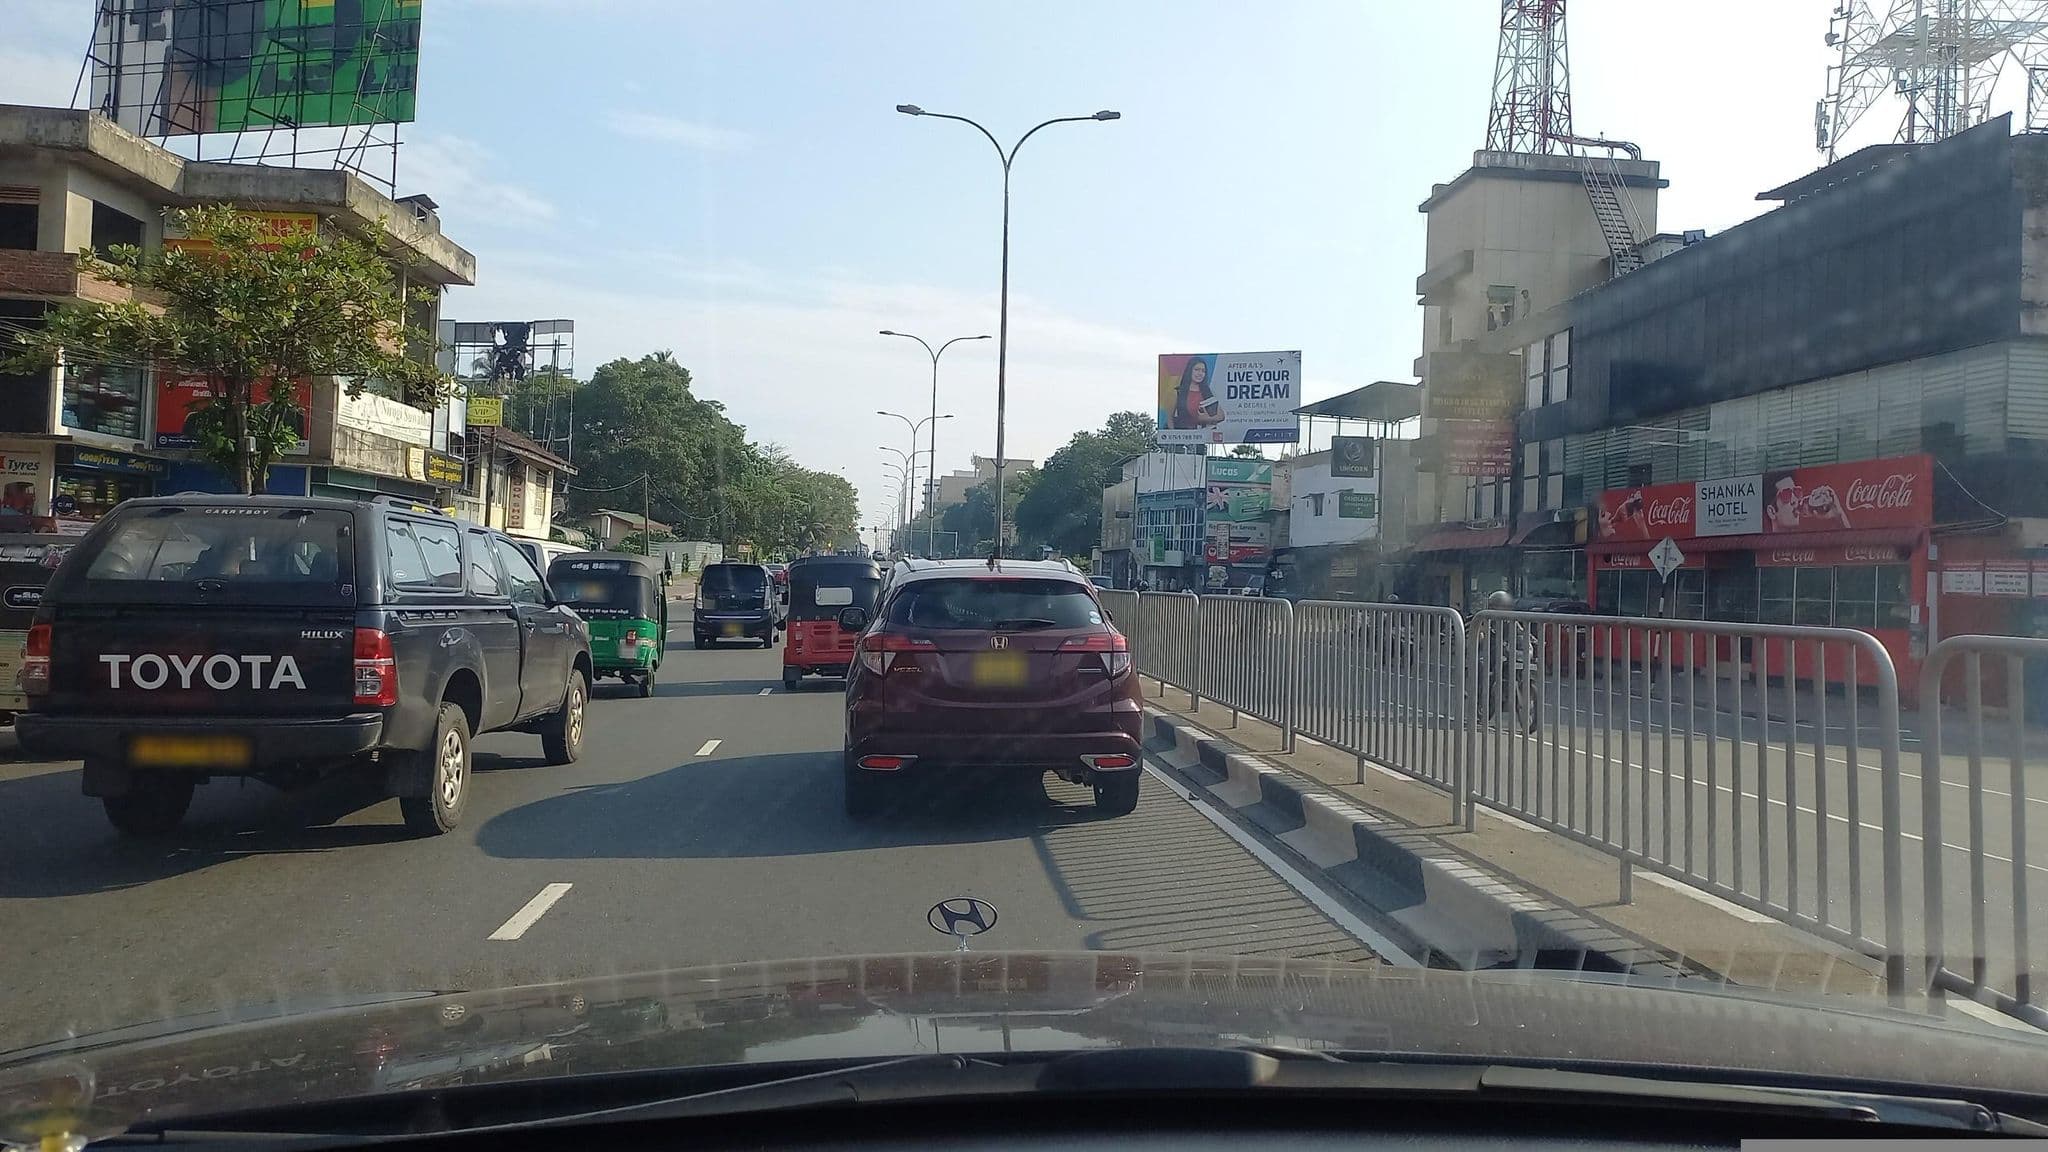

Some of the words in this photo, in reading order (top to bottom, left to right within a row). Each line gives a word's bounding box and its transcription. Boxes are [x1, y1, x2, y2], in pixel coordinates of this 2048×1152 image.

[1227, 371, 1252, 382] LIVE
[1255, 370, 1290, 381] YOUR
[1227, 384, 1290, 400] DREAM
[8, 459, 39, 471] Tyres
[79, 452, 120, 466] GOODYEAR
[1211, 464, 1238, 476] Lucas
[1700, 482, 1756, 500] SHANIKA
[1846, 473, 1917, 511] Coca-Cola
[1647, 496, 1693, 526] Coca-Cola
[1707, 501, 1748, 517] HOTEL
[301, 630, 344, 639] HILUX
[99, 654, 307, 690] TOYOTA
